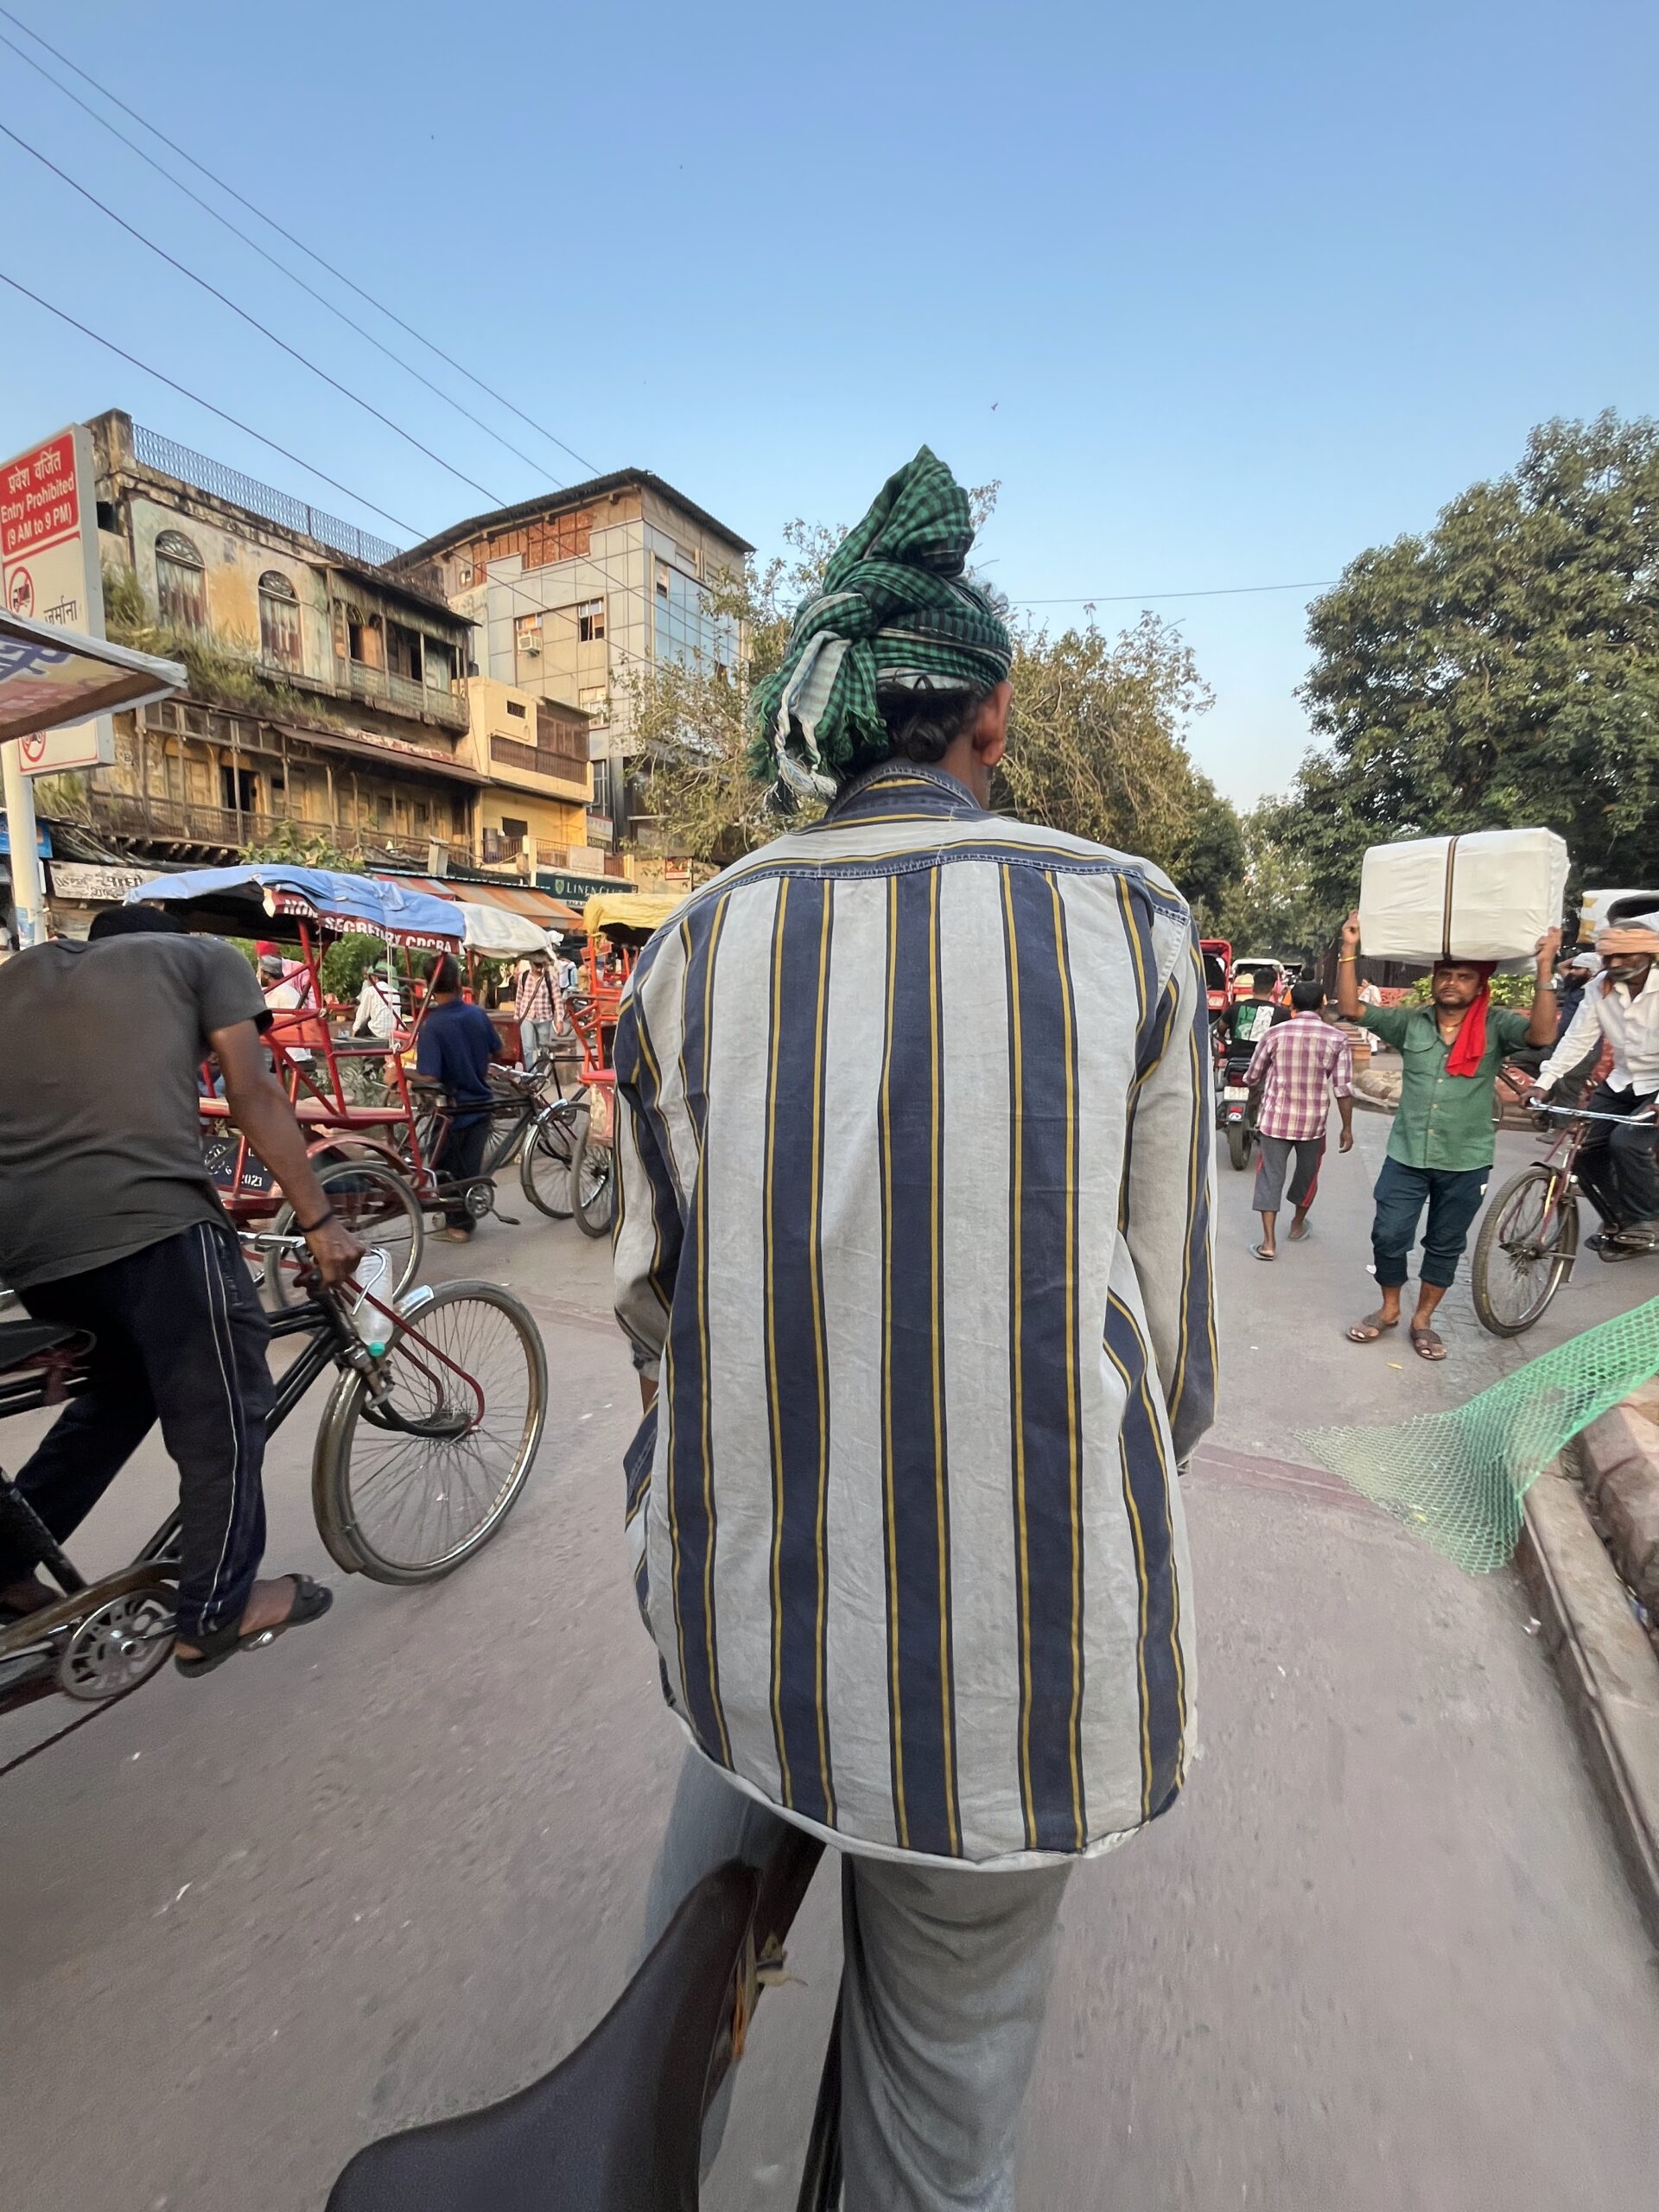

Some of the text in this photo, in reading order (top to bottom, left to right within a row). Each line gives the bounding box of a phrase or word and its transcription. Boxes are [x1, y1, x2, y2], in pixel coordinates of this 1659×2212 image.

[8, 447, 62, 495] प्रवेश वर्जित
[1, 472, 75, 524] Entry Prohibited
[17, 520, 33, 543] AM
[34, 518, 44, 536] to
[45, 512, 51, 530] 9
[53, 502, 73, 526] PM)
[566, 881, 596, 897] LINEN
